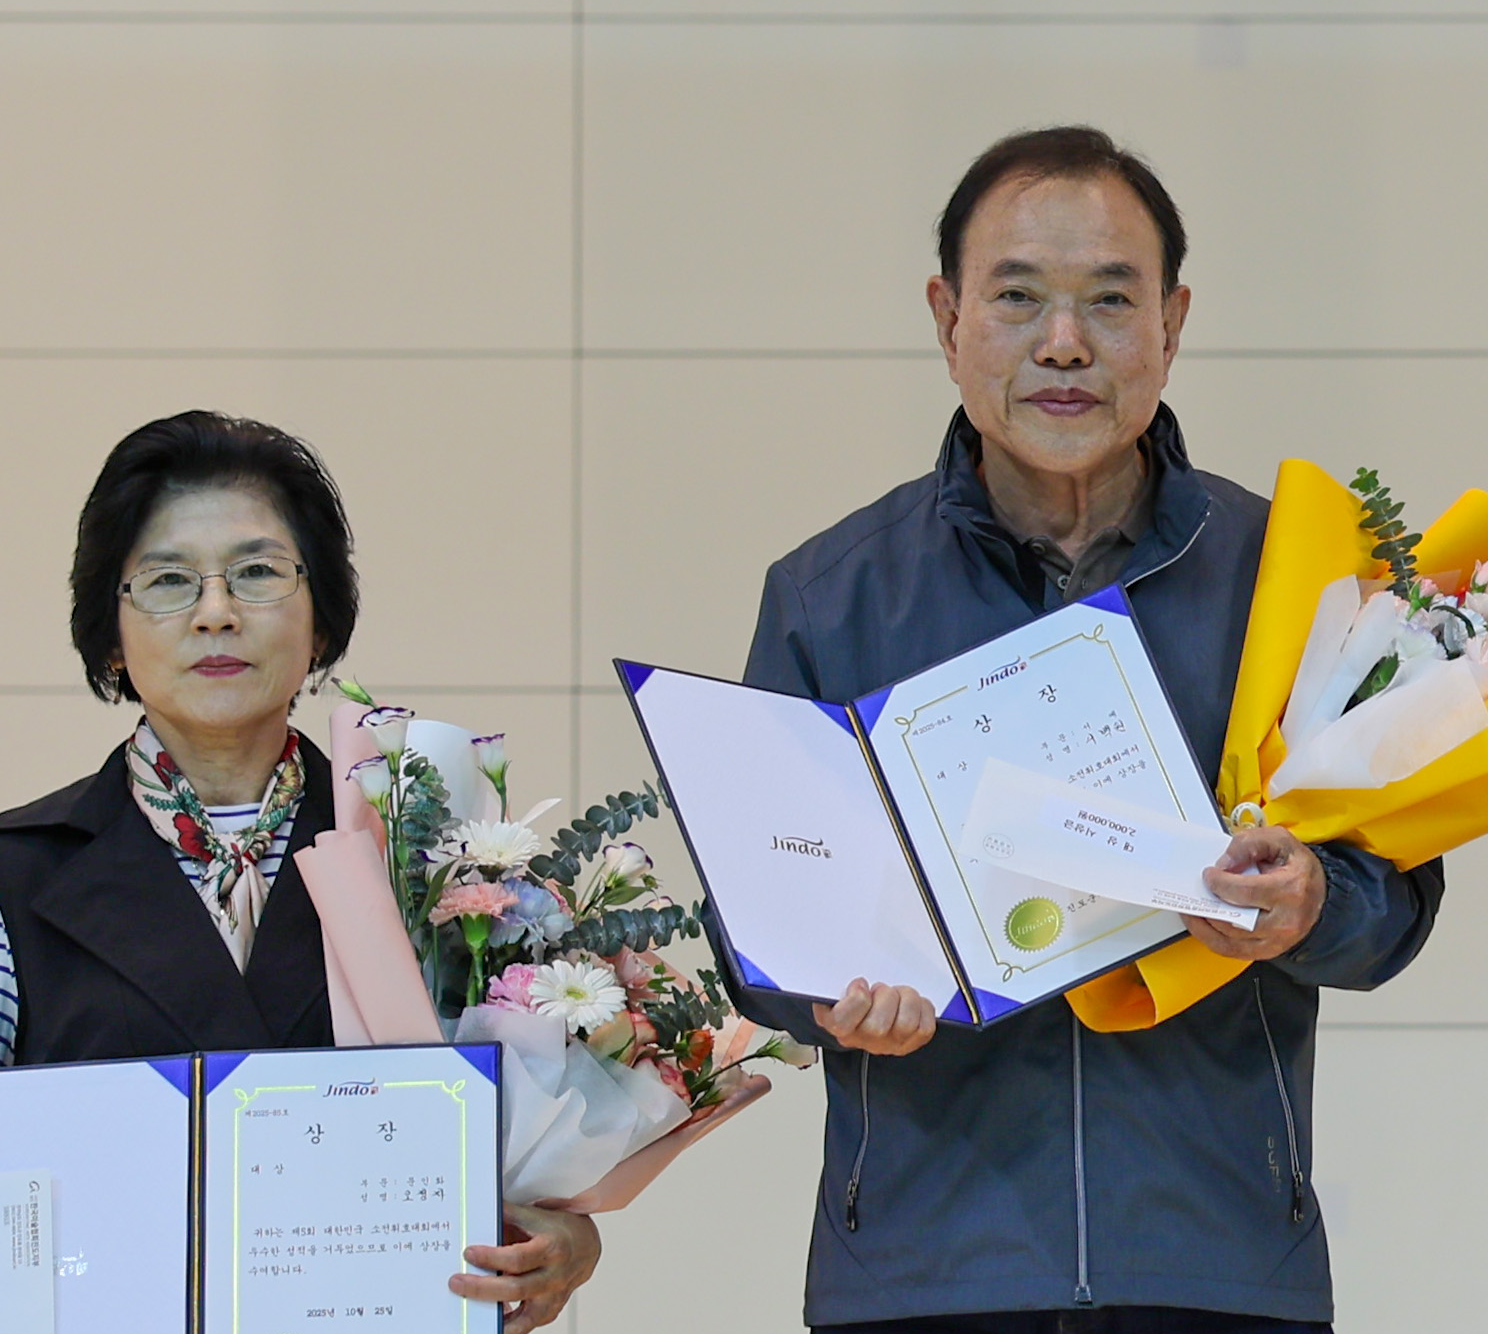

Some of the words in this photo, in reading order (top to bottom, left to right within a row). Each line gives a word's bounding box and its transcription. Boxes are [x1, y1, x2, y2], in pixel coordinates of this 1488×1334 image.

[977, 658, 1020, 691] Jindo
[973, 714, 992, 733] 상
[1038, 684, 1057, 703] 장
[770, 836, 823, 857] Jindo
[1067, 893, 1099, 913] 진도군
[323, 1080, 374, 1097] Jindo
[304, 1123, 325, 1145] 상
[376, 1121, 397, 1142] 장
[306, 1308, 335, 1318] 2025년
[345, 1307, 364, 1316] 10월
[374, 1306, 393, 1316] 25일
